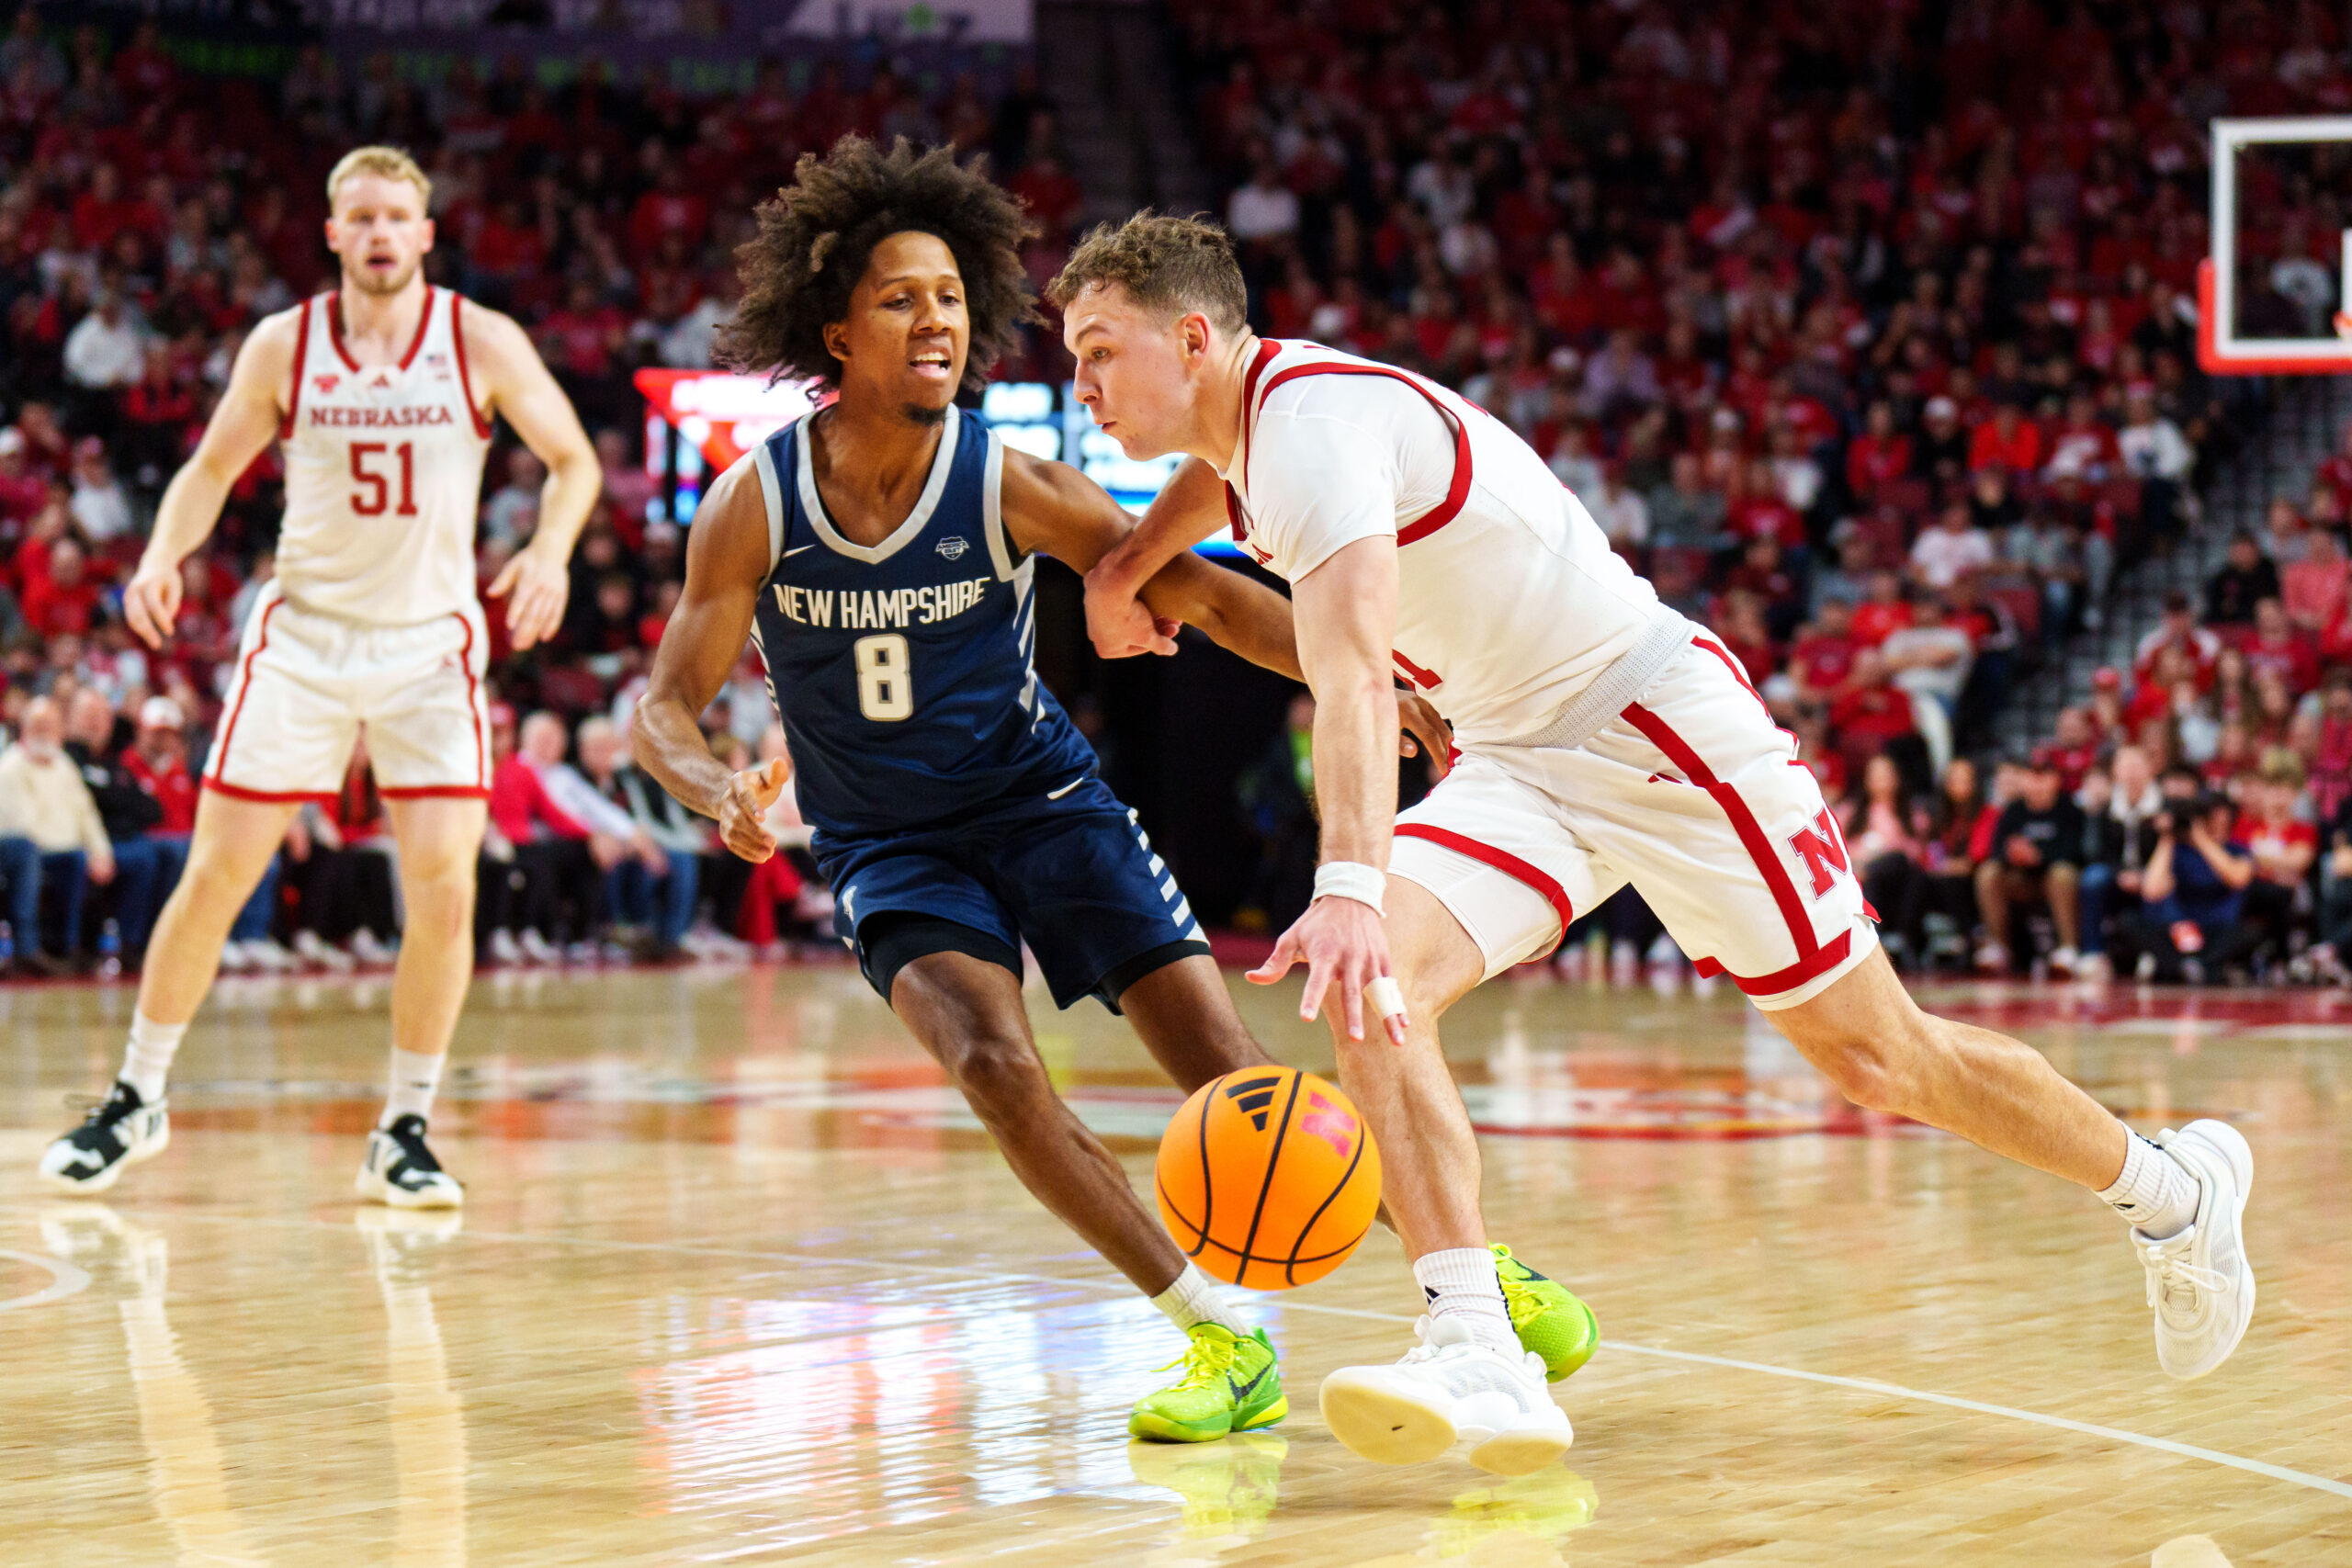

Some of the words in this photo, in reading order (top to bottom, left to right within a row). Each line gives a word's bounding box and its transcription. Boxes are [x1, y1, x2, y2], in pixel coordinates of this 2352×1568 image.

[310, 405, 453, 426] NEBRASKA
[350, 442, 417, 516] 51
[773, 583, 833, 627] NEW
[840, 576, 991, 629] HAMPSHIRE
[854, 633, 913, 722] 8
[1787, 806, 1849, 900] N
